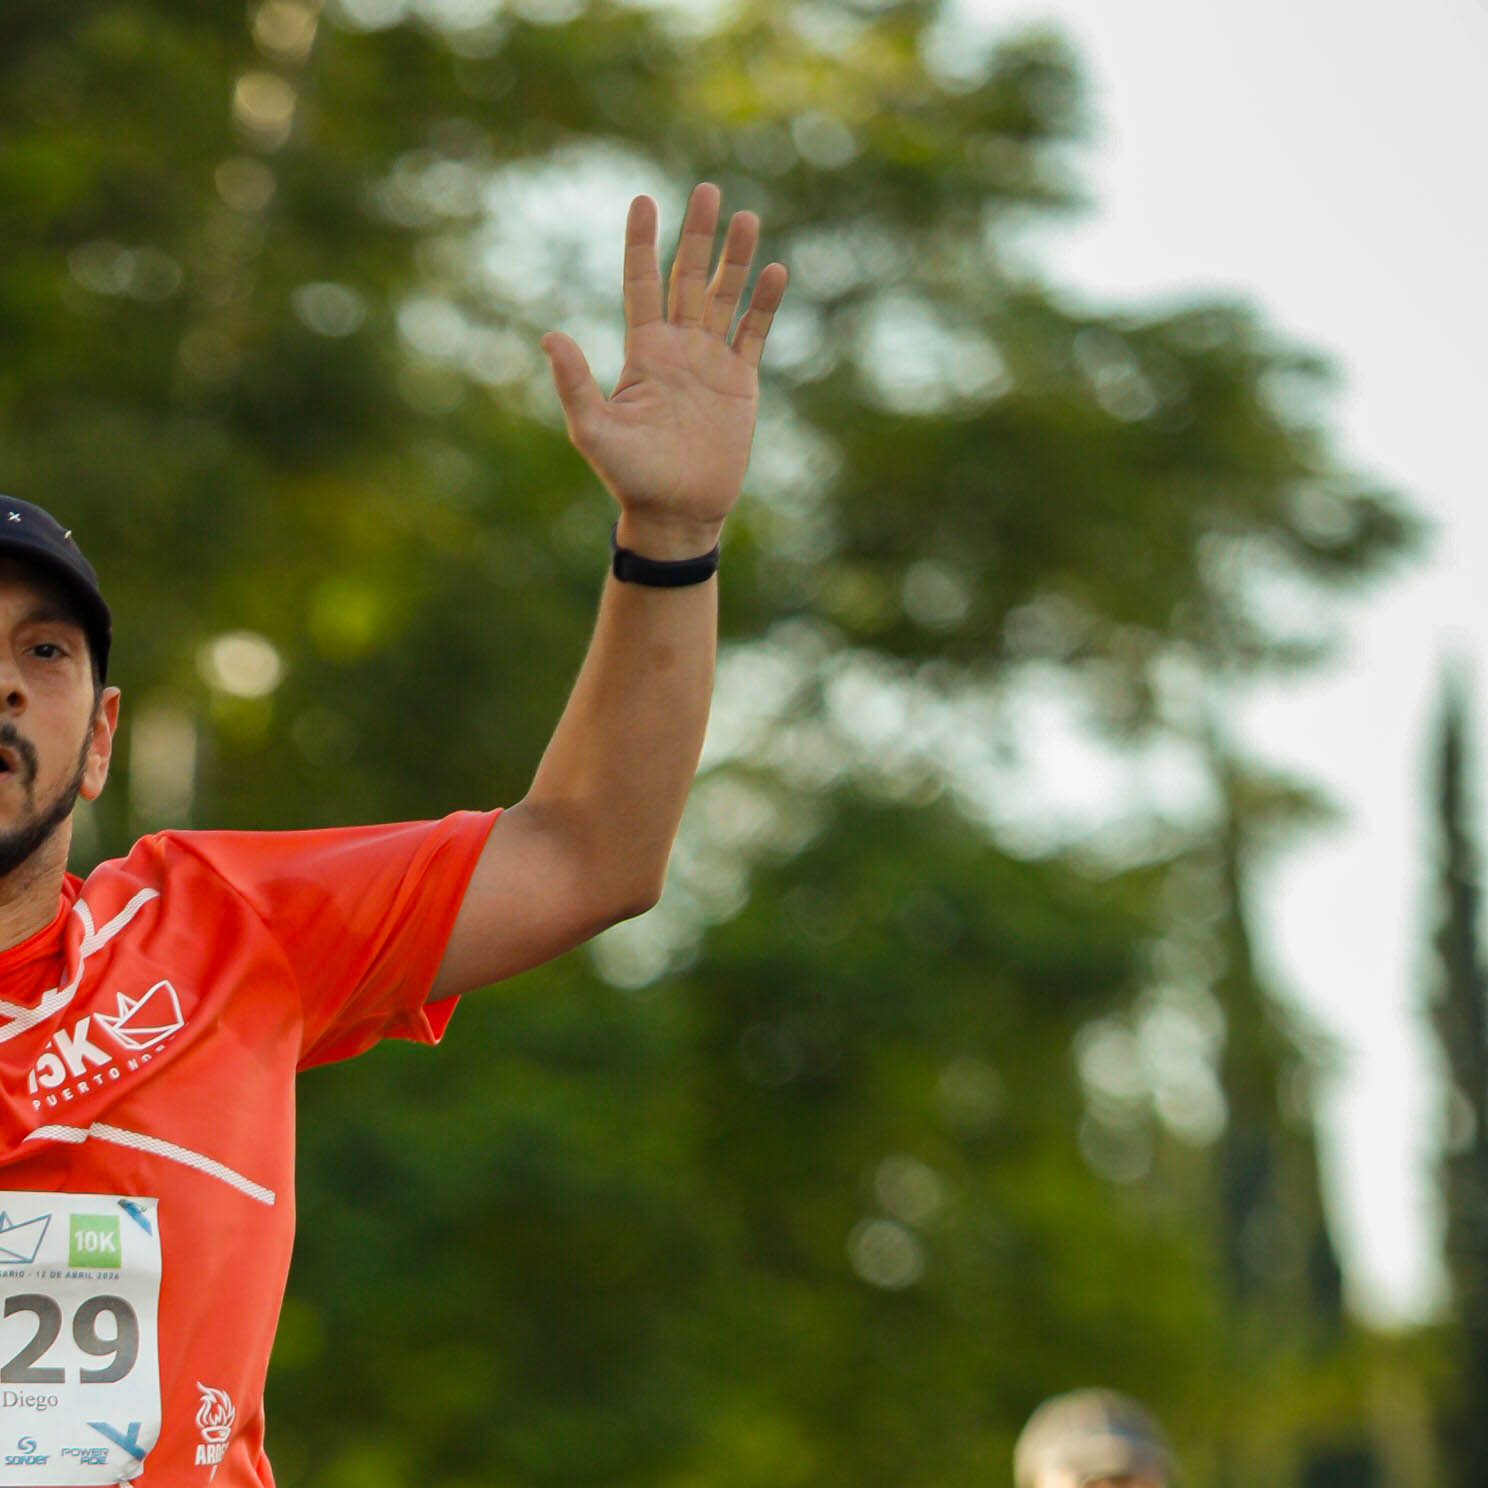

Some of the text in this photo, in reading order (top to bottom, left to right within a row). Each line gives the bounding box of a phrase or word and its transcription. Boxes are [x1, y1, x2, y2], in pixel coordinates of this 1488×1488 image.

[31, 1067, 120, 1111] PUERTO
[74, 1230, 118, 1253] 10K
[35, 1270, 46, 1279] 12
[49, 1270, 62, 1279] DE
[65, 1270, 93, 1280] ABRIL
[2, 1390, 59, 1411] Diego
[61, 1448, 110, 1456] POWER
